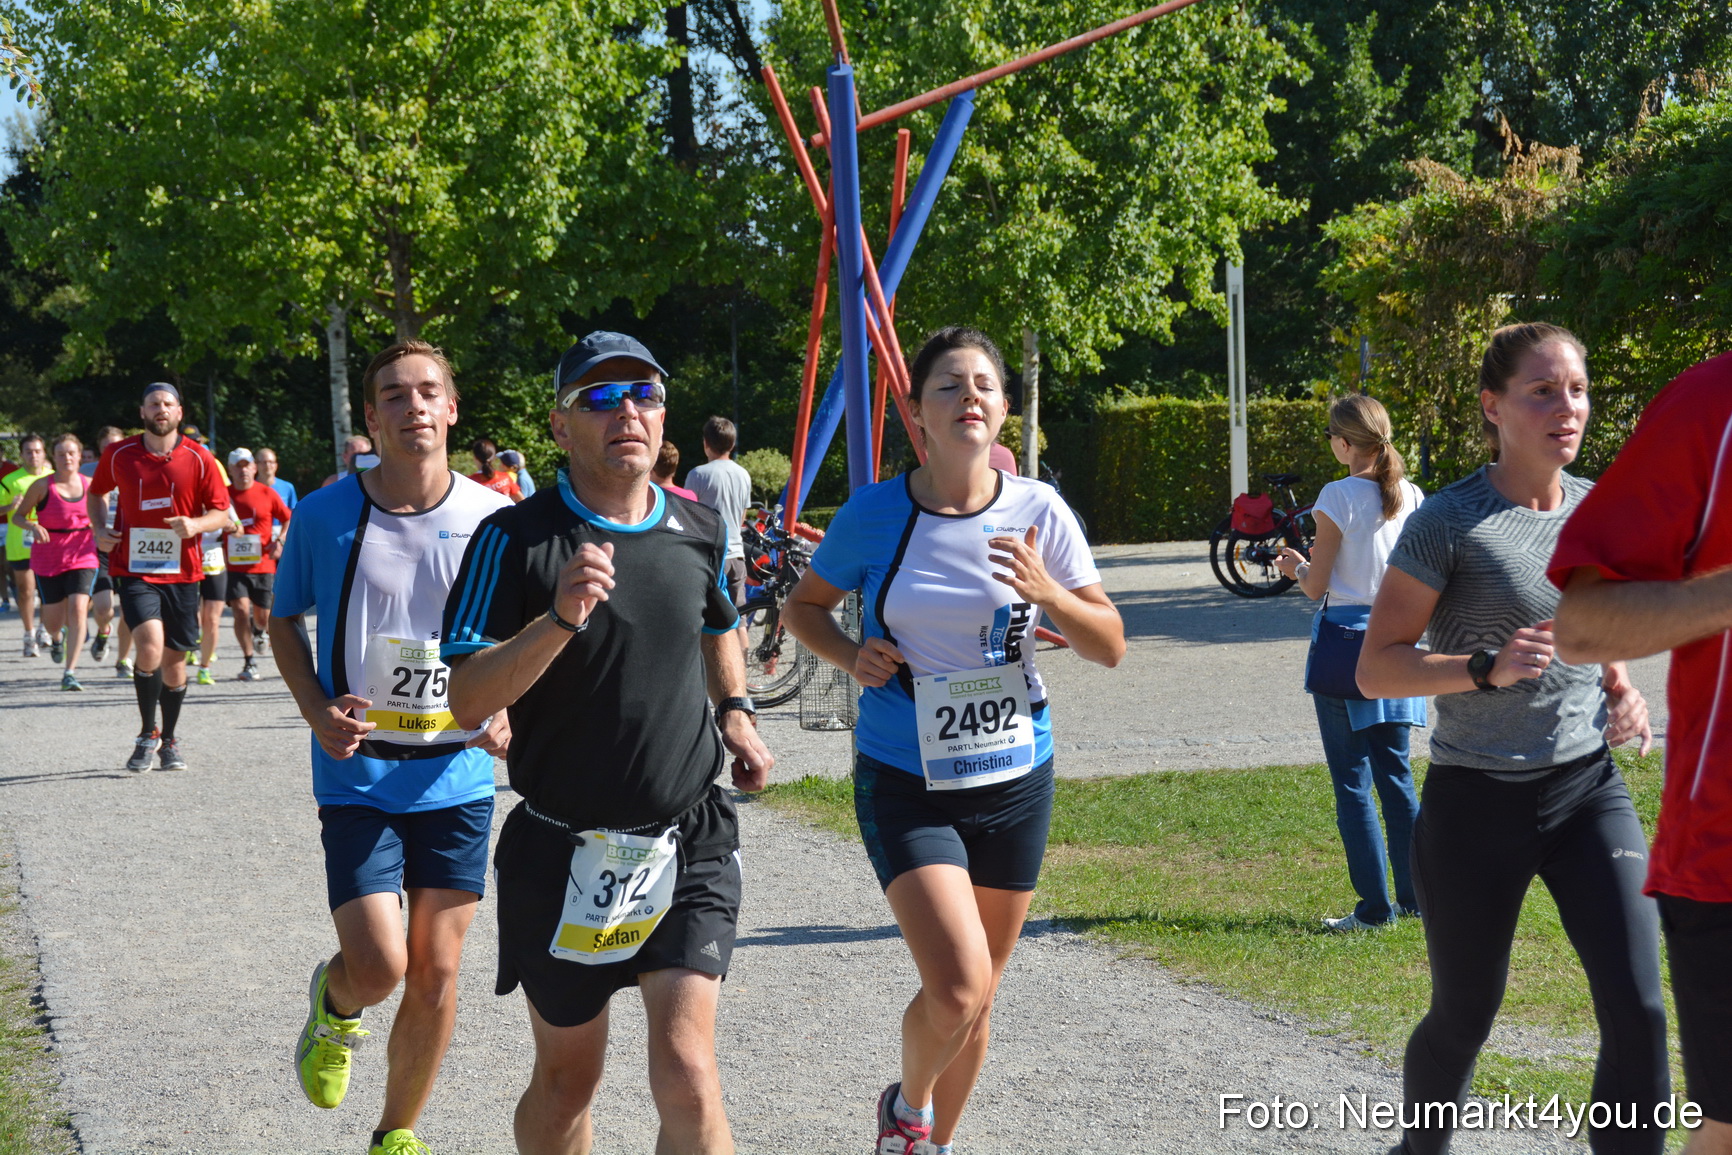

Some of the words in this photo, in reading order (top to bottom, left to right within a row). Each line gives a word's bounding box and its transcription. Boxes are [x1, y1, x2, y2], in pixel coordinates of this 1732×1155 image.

[138, 540, 174, 554] 2442
[235, 543, 252, 552] 267
[391, 666, 447, 699] 275
[949, 676, 1002, 695] BOCK
[387, 700, 410, 709] PARTL
[398, 715, 437, 730] Lukas
[935, 696, 1018, 741] 2492
[947, 744, 973, 753] PARTL
[974, 738, 1006, 749] Neumarkt
[953, 754, 1013, 775] Christina
[606, 843, 658, 862] BOCK
[593, 867, 651, 908] 312
[585, 913, 609, 923] PARTL
[593, 929, 640, 948] Stefan
